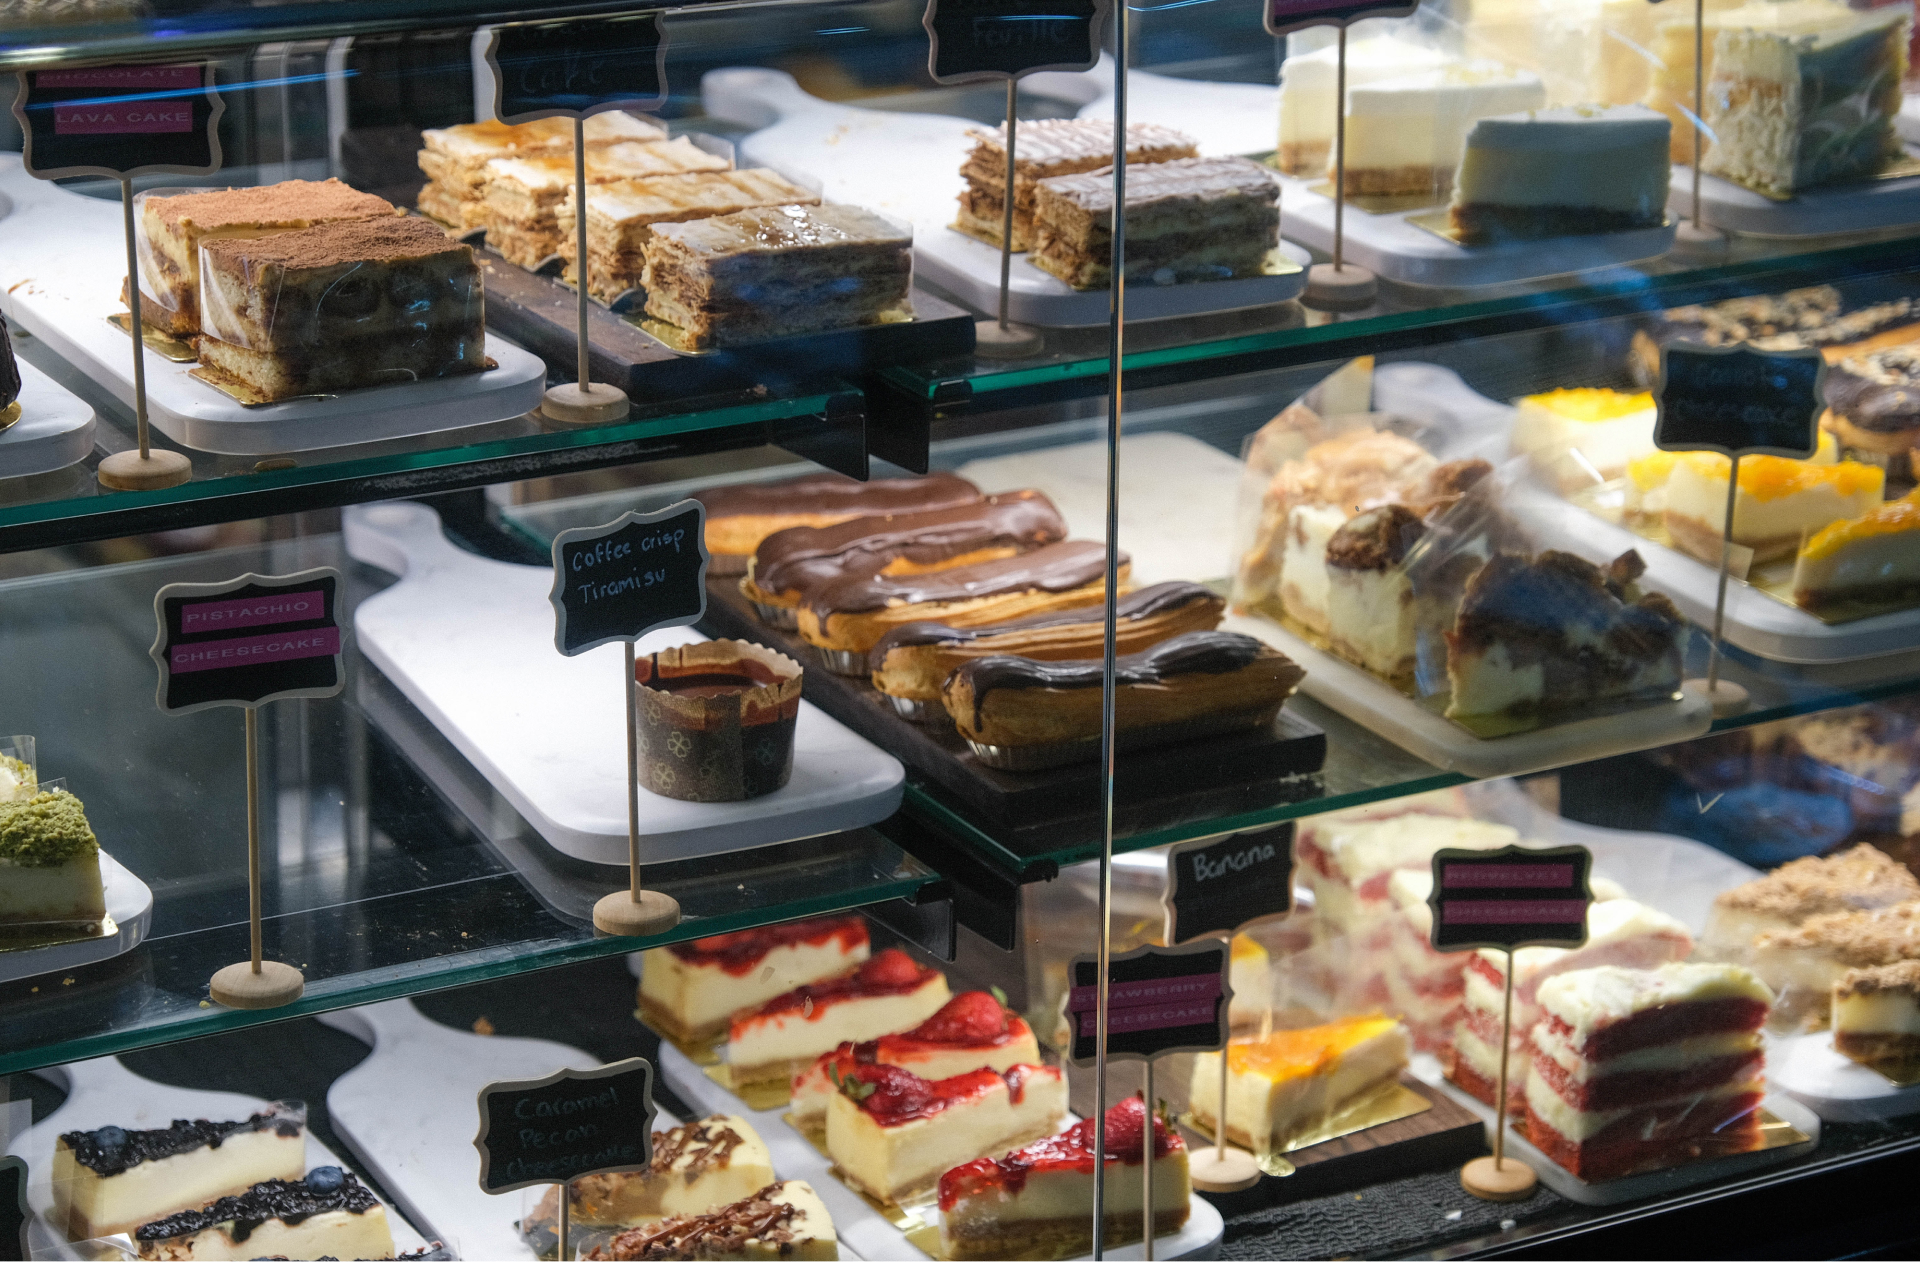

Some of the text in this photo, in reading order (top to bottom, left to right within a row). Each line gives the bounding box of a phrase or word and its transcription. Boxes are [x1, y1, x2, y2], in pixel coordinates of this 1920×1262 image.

[56, 111, 190, 124] LAVA CAKE
[572, 540, 631, 572] Coffee
[577, 567, 665, 604] Tiramisu
[186, 601, 309, 623] PISTACHIO
[174, 637, 325, 664] CHEESECAKE
[1192, 844, 1275, 882] Banana
[1074, 982, 1208, 1003] STAWBERRY
[1083, 1006, 1212, 1029] CEESECAKE
[514, 1086, 619, 1120] Caramel
[518, 1123, 598, 1149] Pecan
